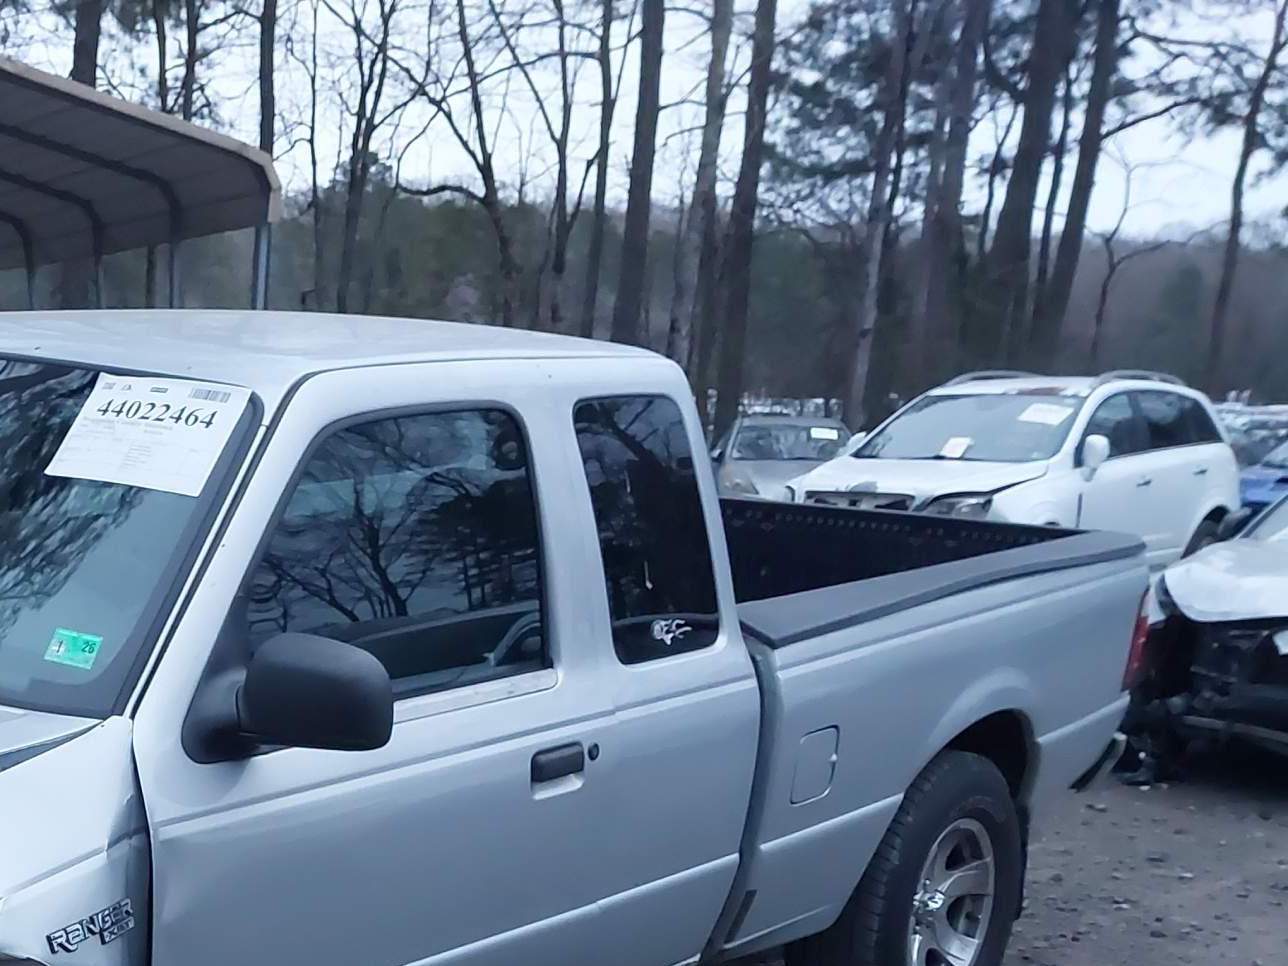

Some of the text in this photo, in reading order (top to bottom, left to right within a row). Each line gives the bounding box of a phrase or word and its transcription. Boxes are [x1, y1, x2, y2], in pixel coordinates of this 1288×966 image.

[97, 398, 218, 429] 44022464
[81, 640, 97, 654] 26
[46, 897, 134, 954] RANGER
